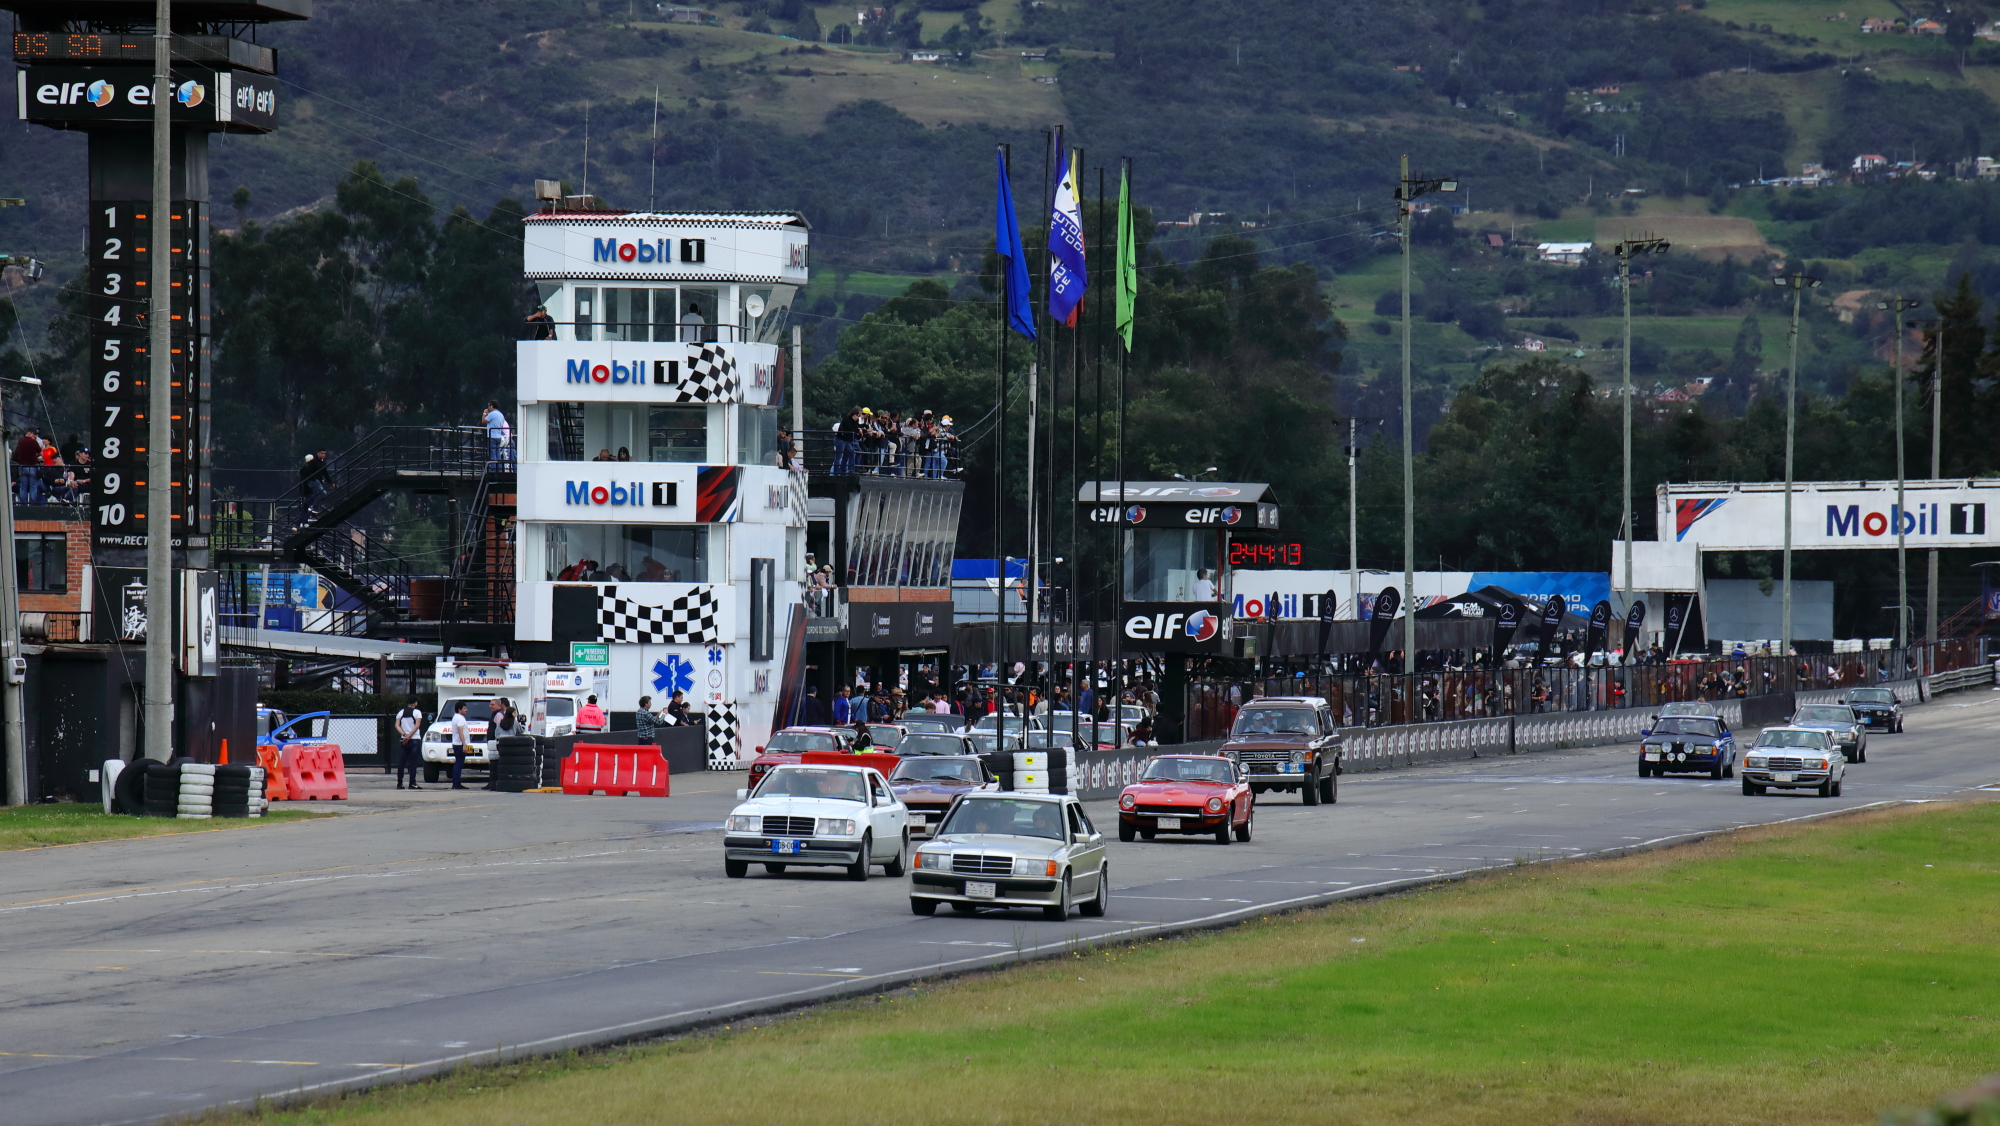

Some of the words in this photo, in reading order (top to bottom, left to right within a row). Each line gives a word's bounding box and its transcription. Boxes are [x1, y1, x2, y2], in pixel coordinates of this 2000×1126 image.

[68, 34, 101, 56] SA
[36, 82, 85, 105] elf
[236, 86, 249, 108] elf
[256, 89, 269, 110] elf
[104, 207, 116, 229] 1
[187, 207, 192, 229] 1
[103, 238, 122, 260] 2
[187, 238, 193, 260] 2
[594, 237, 671, 263] Mobil
[103, 273, 122, 295] 3
[187, 274, 193, 296] 3
[103, 305, 121, 327] 4
[188, 306, 193, 328] 4
[103, 339, 121, 361] 5
[189, 340, 194, 362] 5
[103, 371, 121, 393] 6
[566, 358, 646, 384] Mobil
[188, 372, 194, 394] 6
[104, 406, 121, 428] 7
[188, 407, 193, 429] 7
[102, 437, 121, 459] 8
[188, 438, 193, 460] 8
[103, 472, 121, 495] 9
[188, 473, 193, 496] 9
[565, 480, 644, 506] Mobil
[1100, 487, 1190, 496] elf
[98, 503, 126, 526] 10
[187, 504, 194, 527] 10
[1184, 507, 1221, 523] elf
[1826, 503, 1938, 537] Mobil
[1230, 543, 1301, 565] 2:44:13
[1232, 593, 1297, 618] Mobil
[1124, 613, 1184, 639] elf
[1055, 634, 1064, 654] elf
[508, 672, 522, 680] TAB
[1075, 763, 1085, 790] elf
[1091, 762, 1101, 788] elf
[1107, 761, 1116, 787] elf
[1122, 760, 1132, 785] elf
